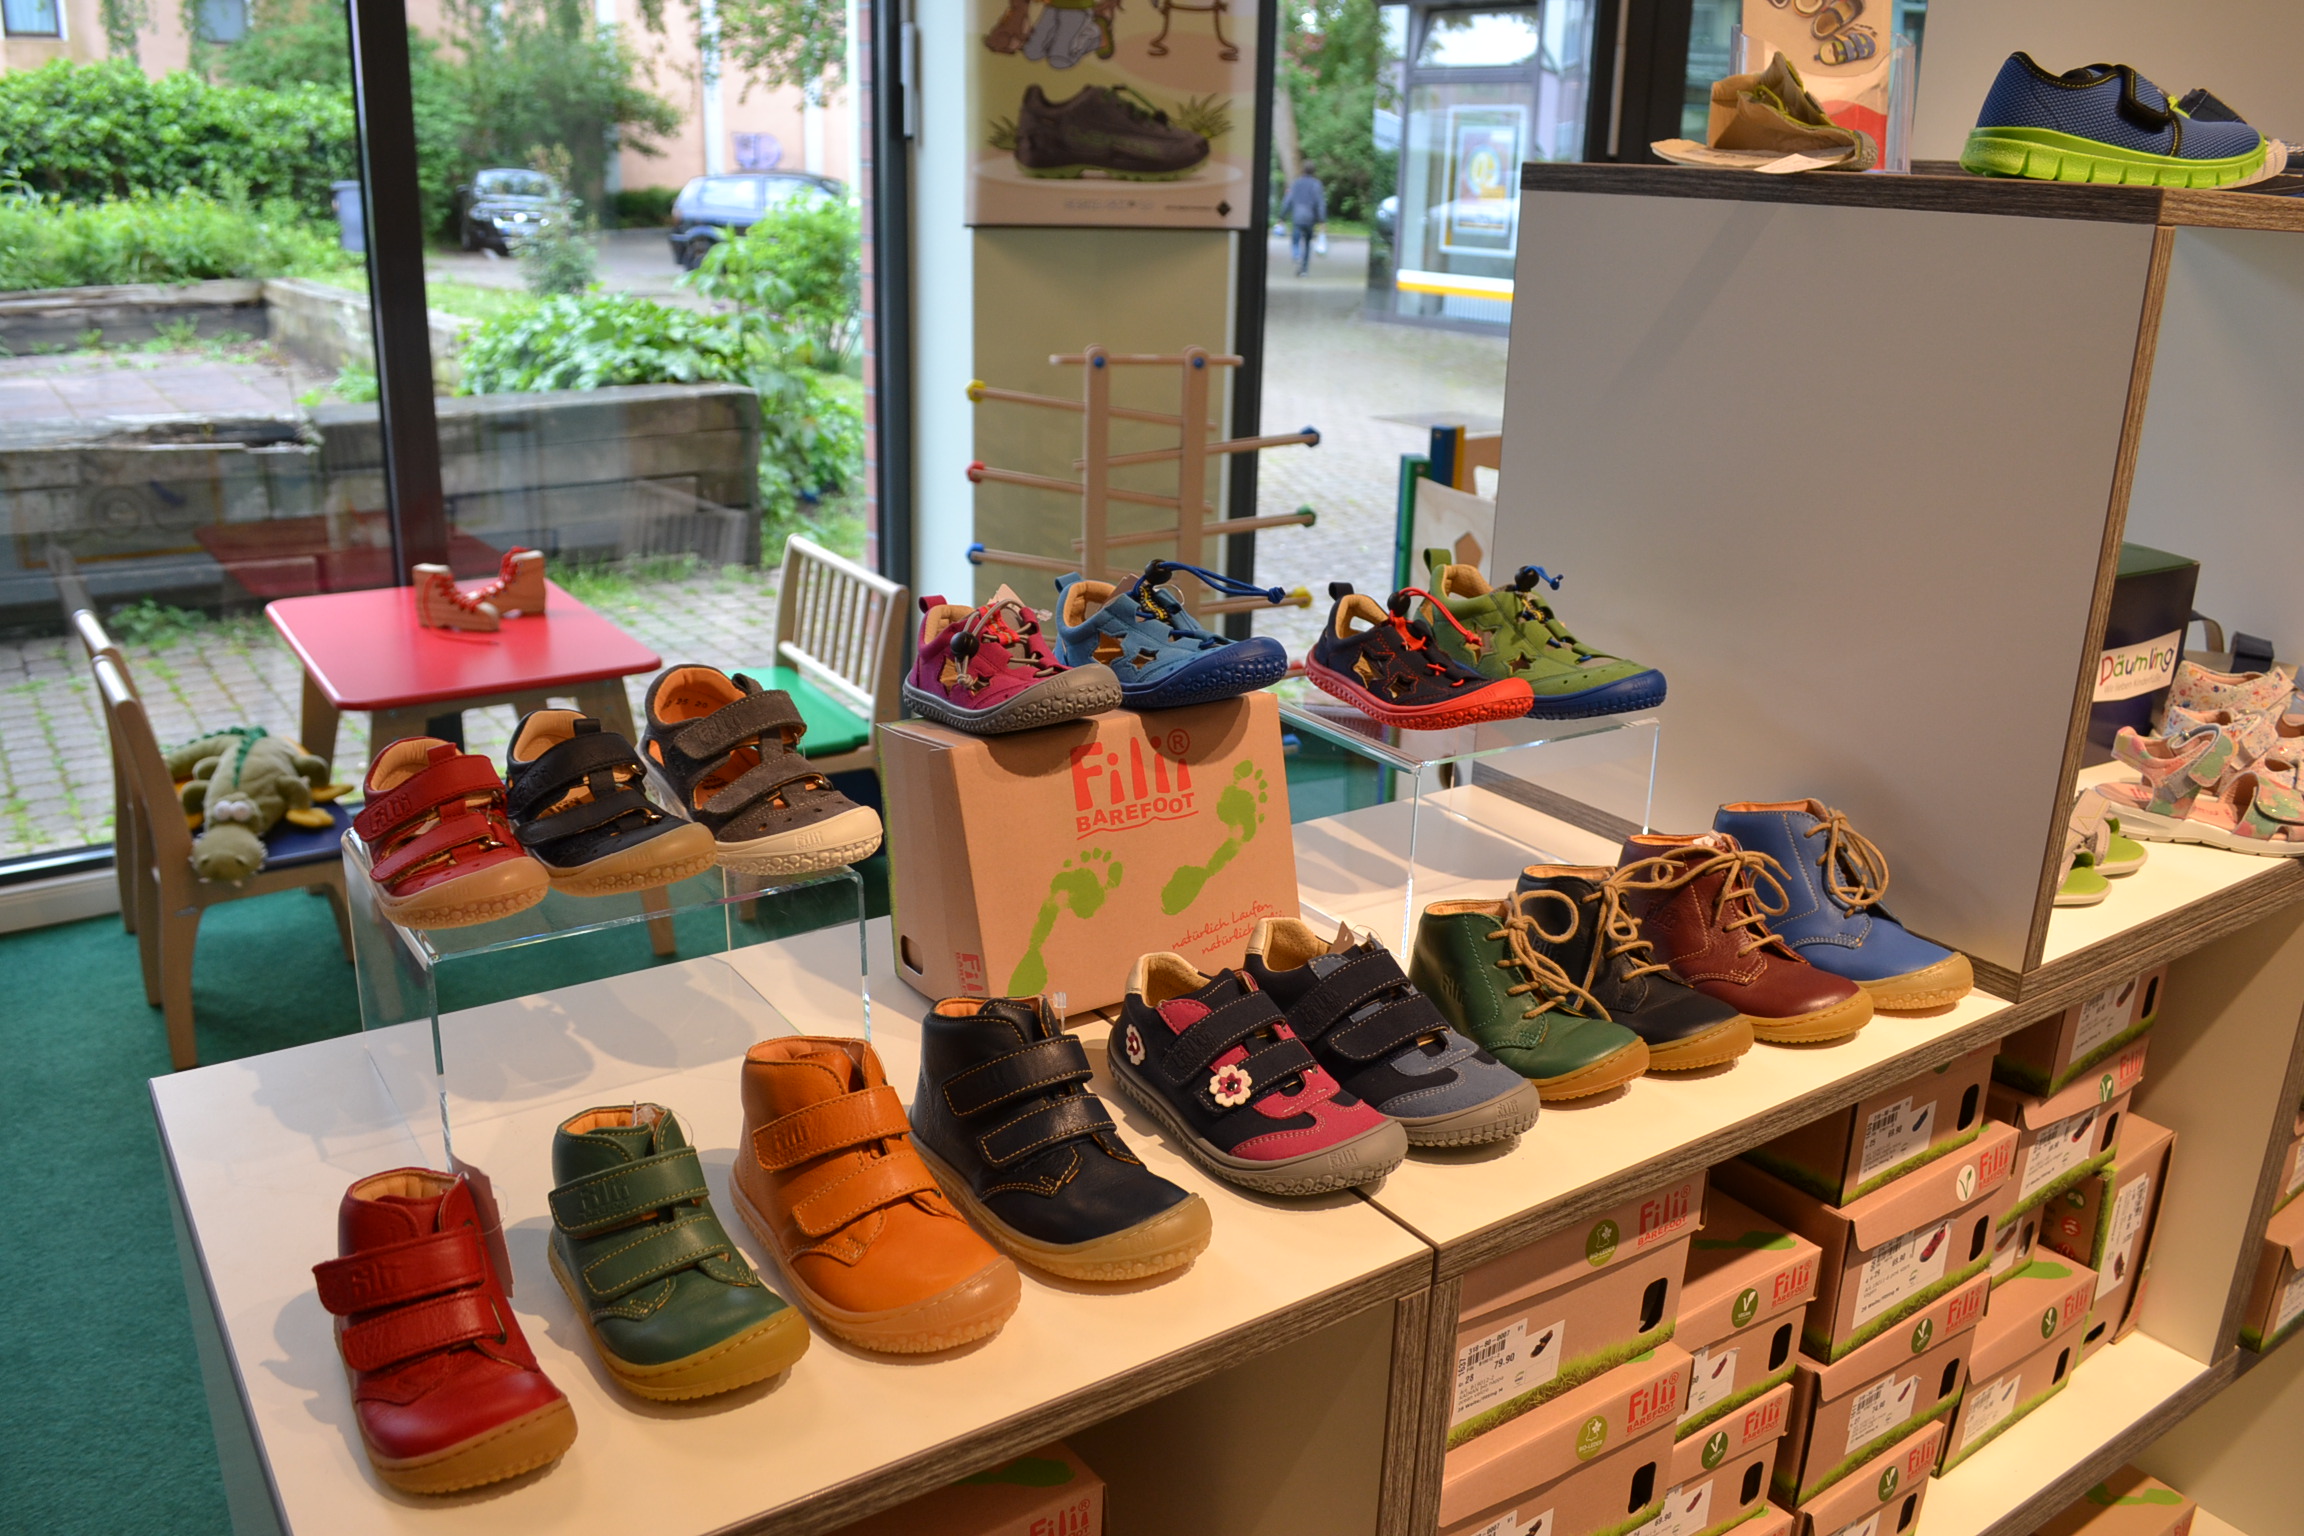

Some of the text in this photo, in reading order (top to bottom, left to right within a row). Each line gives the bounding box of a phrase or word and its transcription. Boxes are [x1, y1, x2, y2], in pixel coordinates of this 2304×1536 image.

[2099, 647, 2175, 686] Däumling
[1076, 792, 1195, 833] BAREFOOT
[1171, 918, 1230, 950] natürlich
[1639, 1185, 1692, 1236] Filii
[1637, 1215, 1688, 1247] BAREFOOT
[1493, 1352, 1516, 1370] 79.90
[1628, 1371, 1680, 1424] Filii
[1626, 1400, 1676, 1434] BAREFOOT
